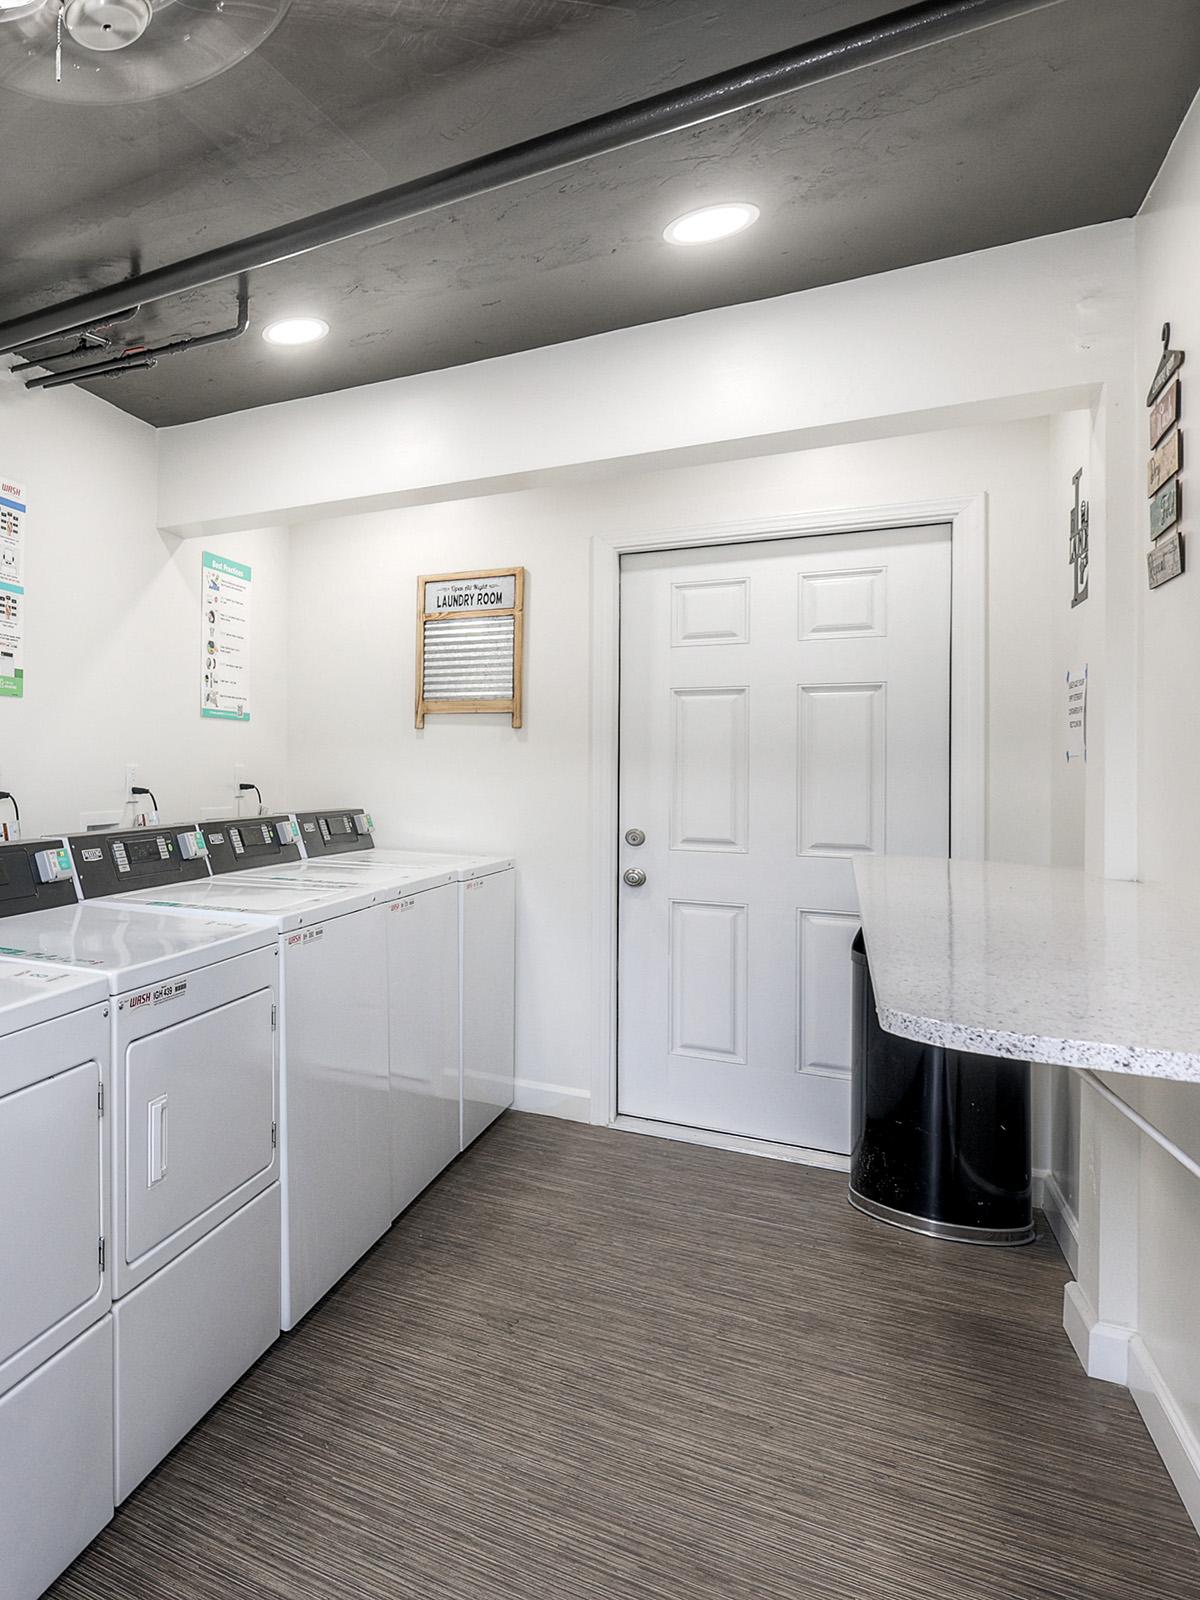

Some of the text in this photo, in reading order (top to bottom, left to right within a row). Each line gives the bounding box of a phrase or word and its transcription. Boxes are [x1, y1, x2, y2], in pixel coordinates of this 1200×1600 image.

[2, 483, 21, 496] WASH
[437, 592, 503, 608] LAUNDRY ROOM
[130, 992, 151, 1008] WASH
